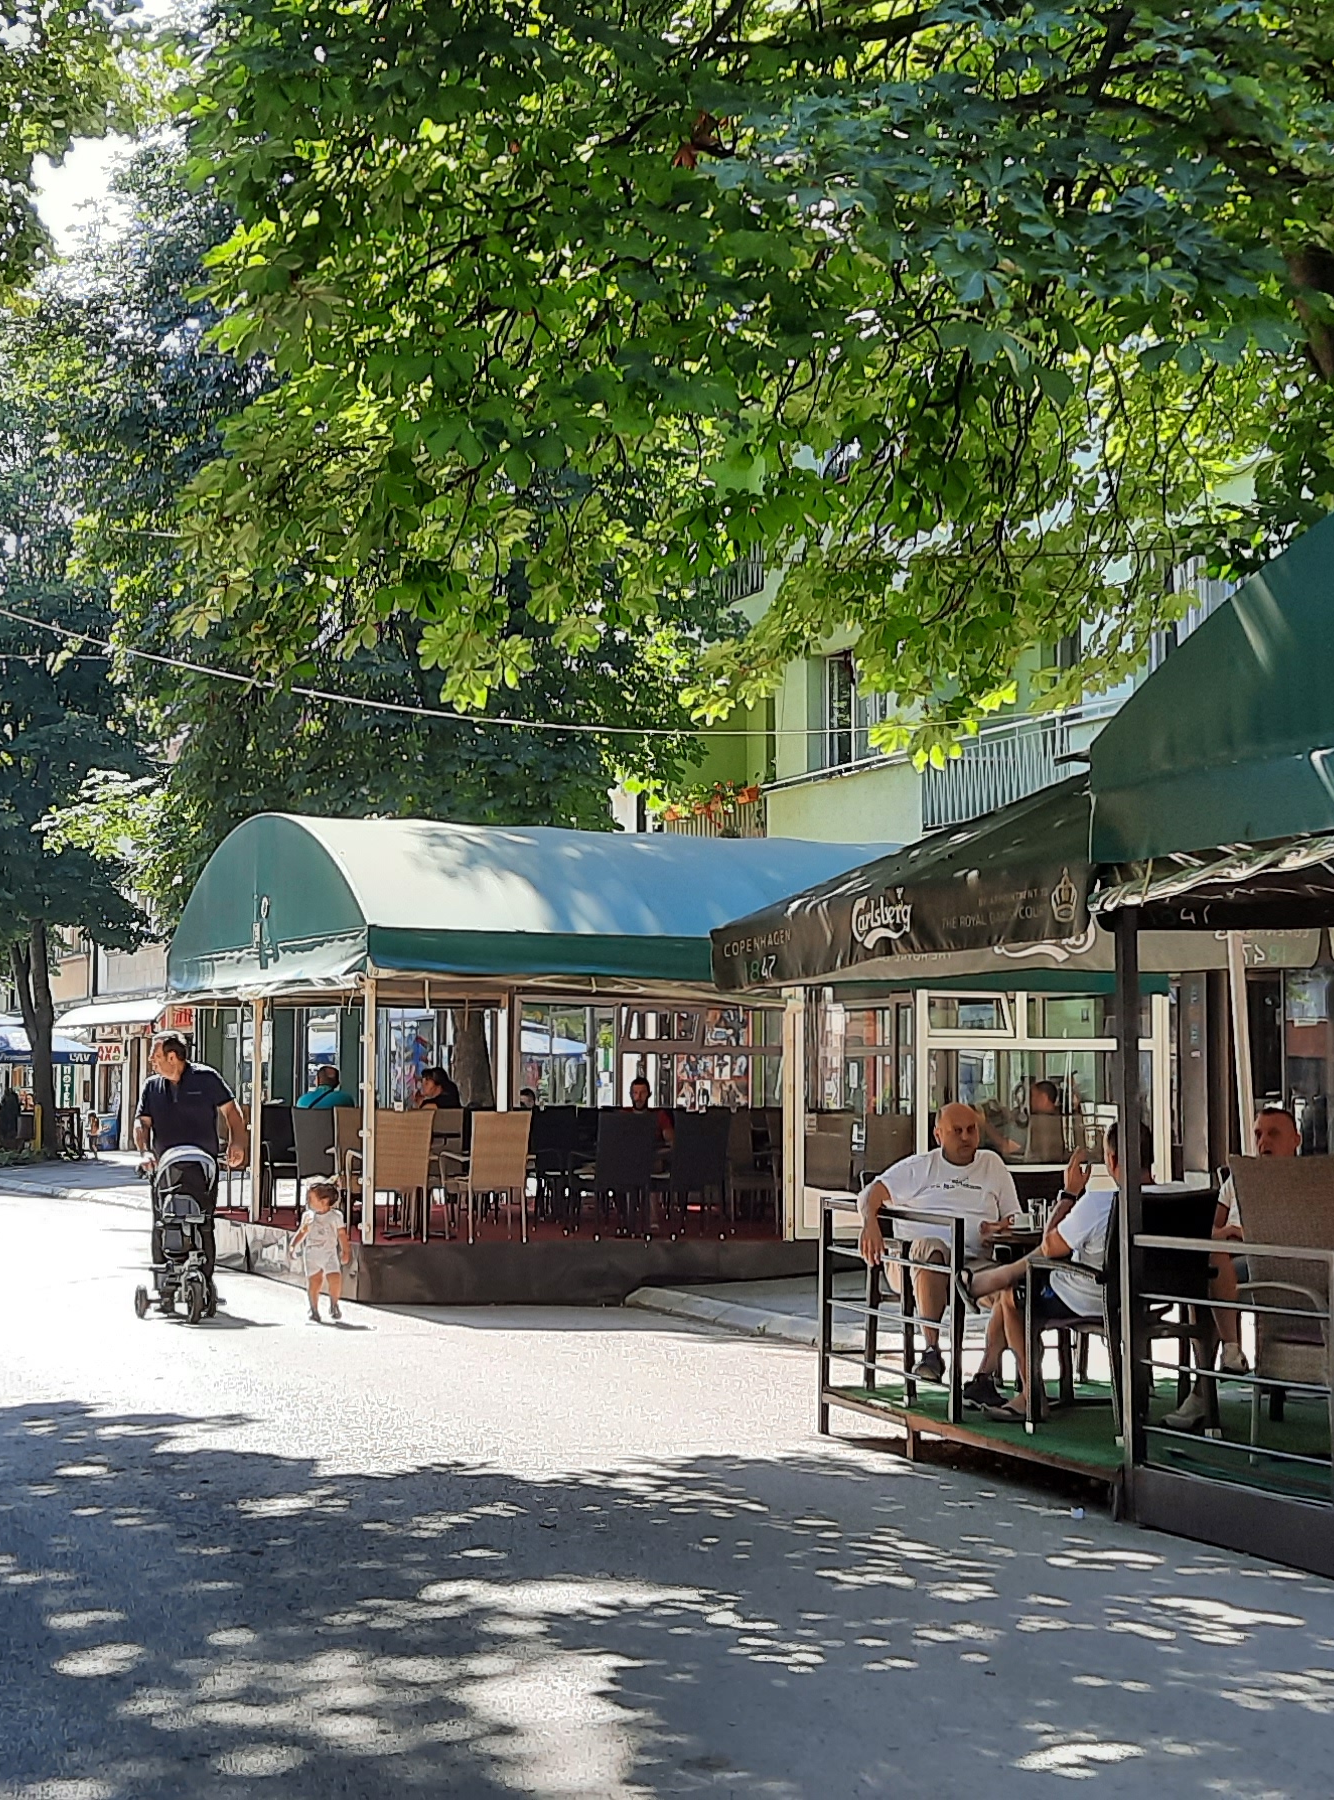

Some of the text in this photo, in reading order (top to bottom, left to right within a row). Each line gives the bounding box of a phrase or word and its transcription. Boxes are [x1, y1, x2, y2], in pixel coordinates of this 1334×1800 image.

[852, 895, 913, 944] Carlsberg
[960, 914, 987, 928] ROYAL
[723, 928, 792, 958] COPENHAGEN
[743, 954, 777, 982] 1847
